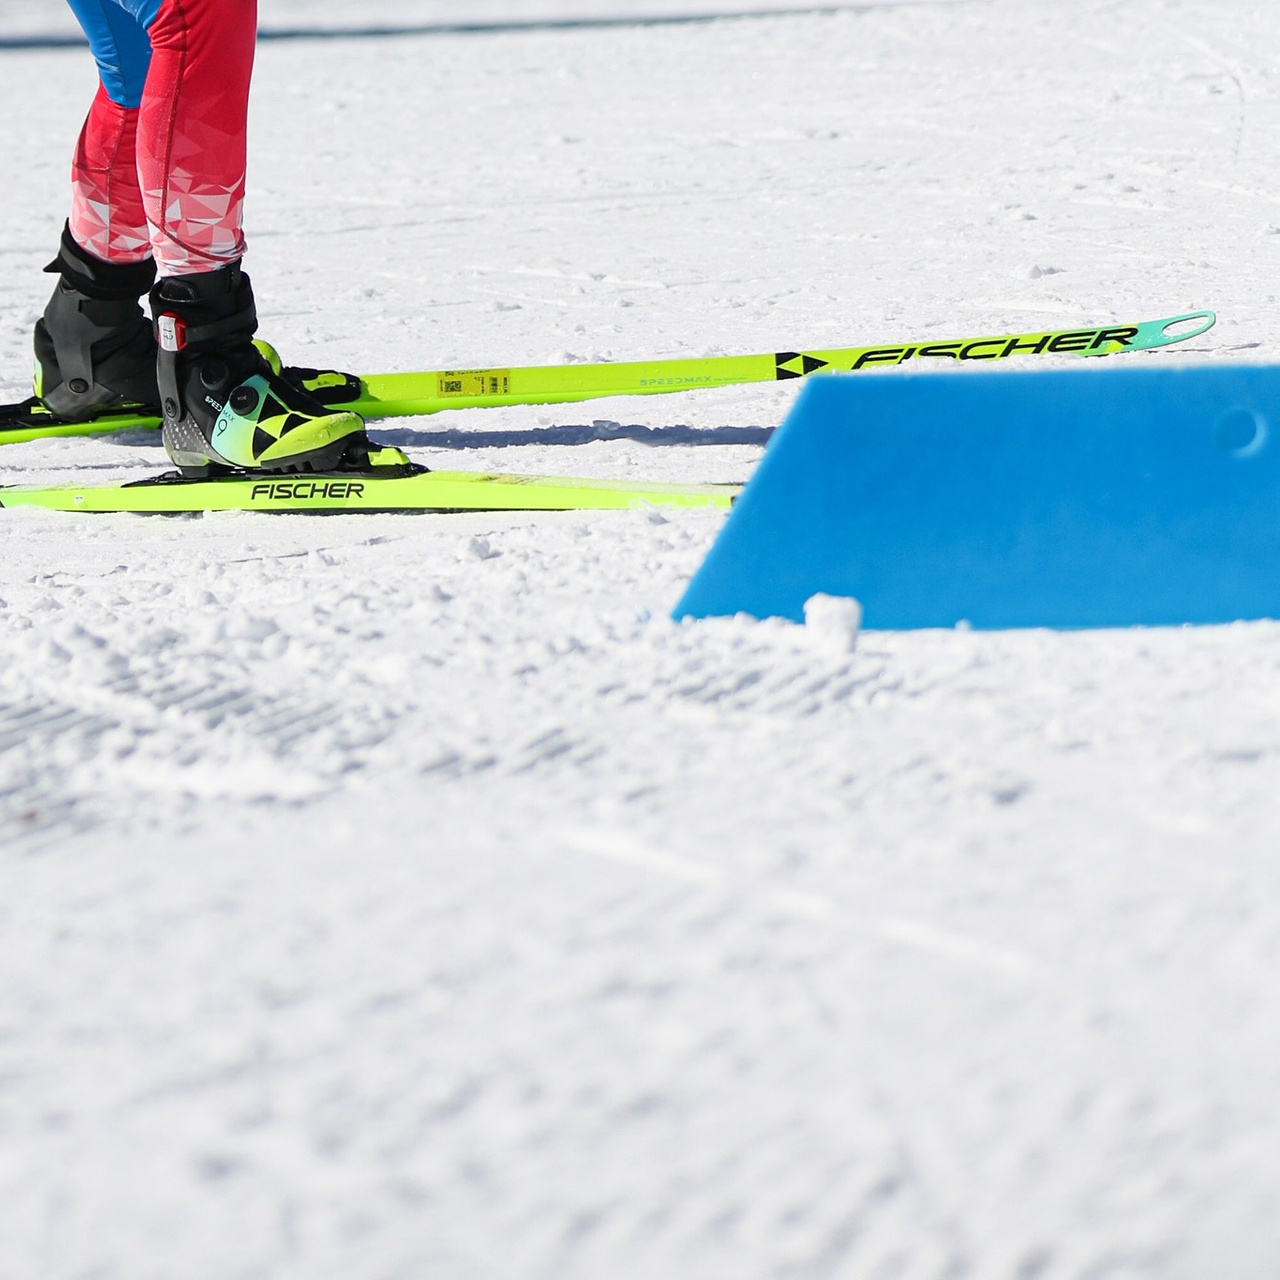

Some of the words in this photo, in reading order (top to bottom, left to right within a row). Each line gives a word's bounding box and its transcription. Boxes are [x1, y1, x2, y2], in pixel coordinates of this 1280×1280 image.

[852, 327, 1138, 370] FISCHER
[204, 395, 223, 412] SPEED
[223, 410, 235, 423] MAX
[217, 419, 228, 437] 9
[251, 483, 365, 500] FISCHER
